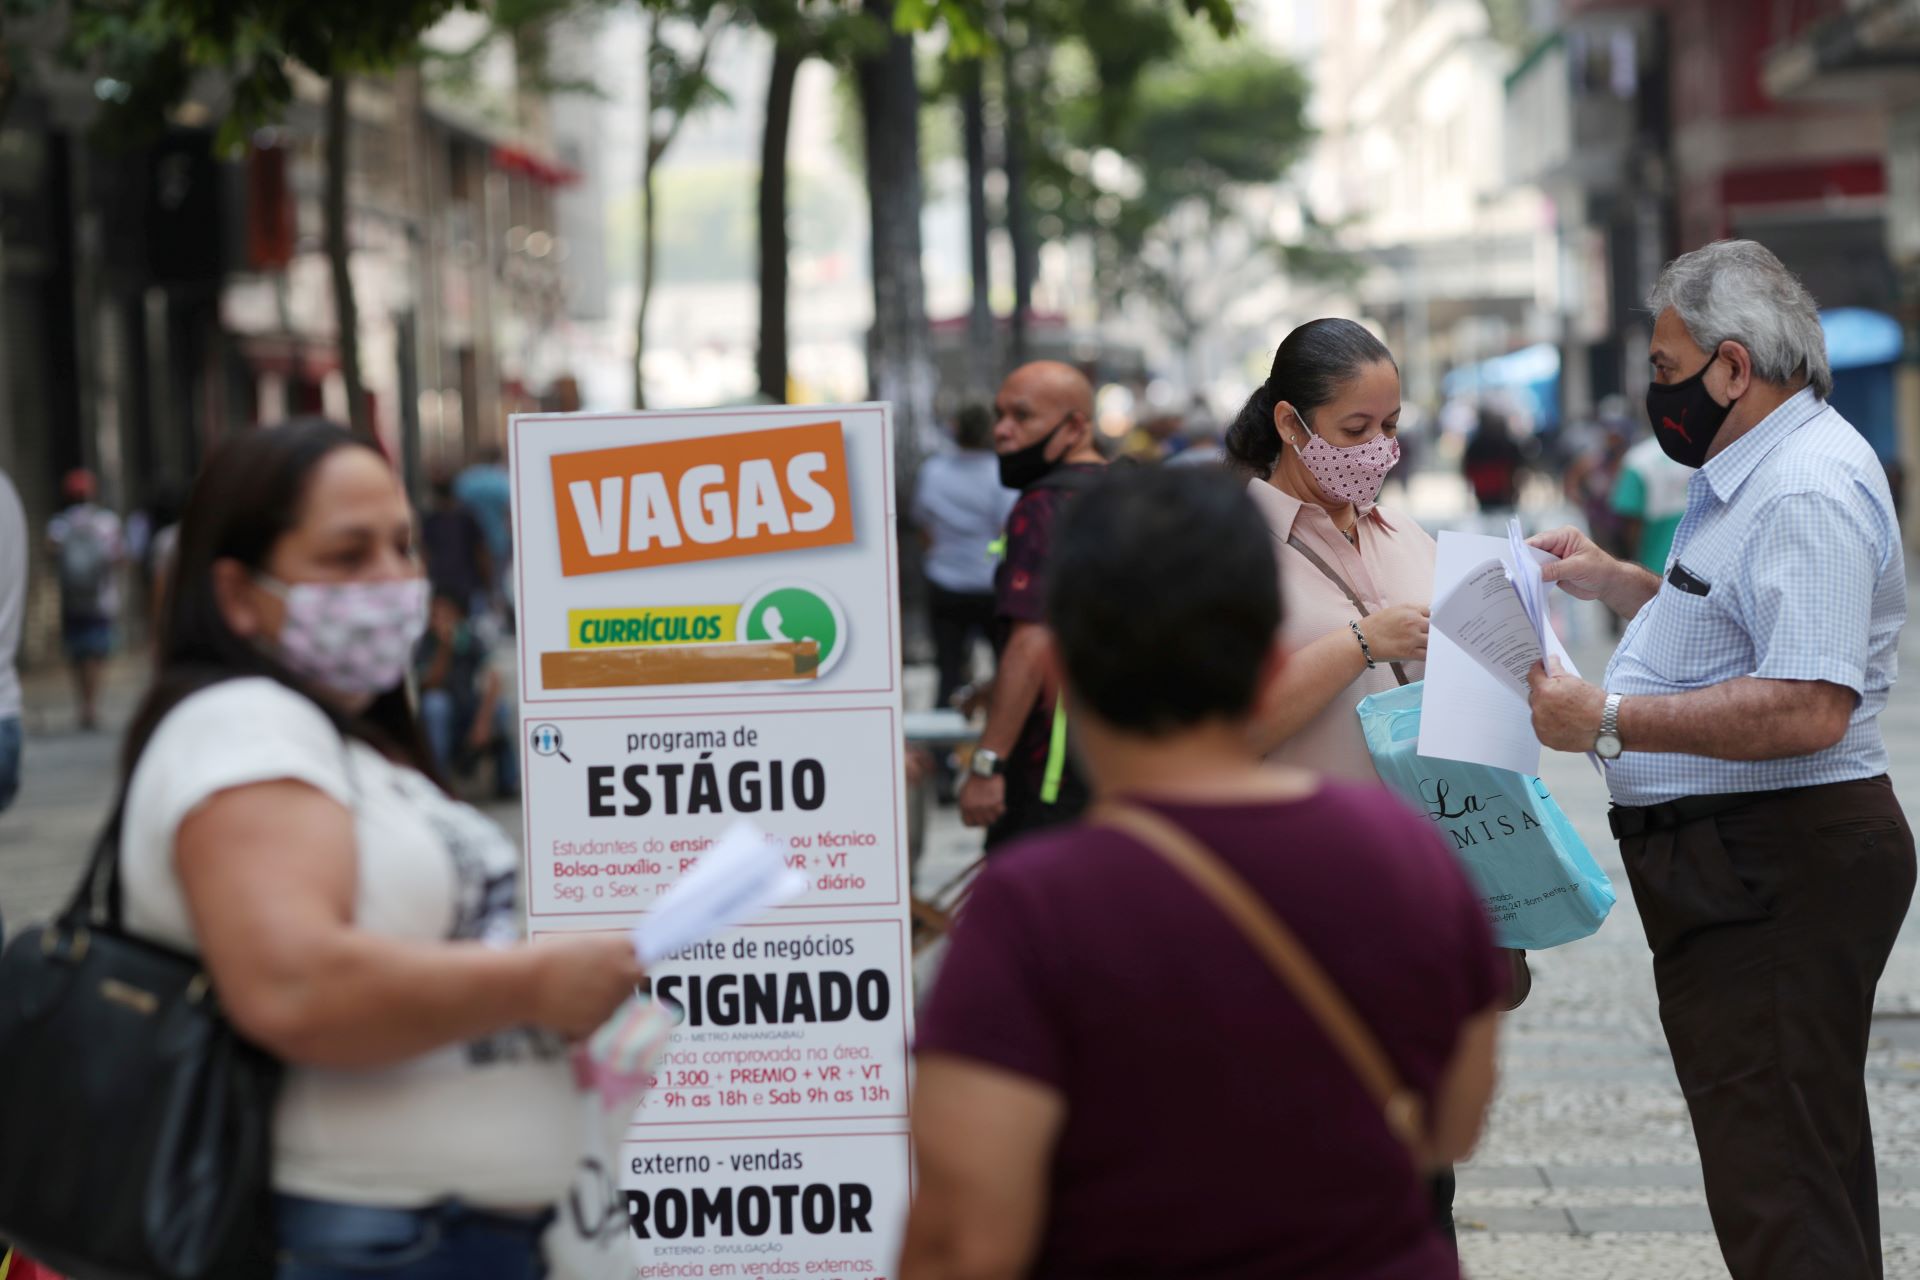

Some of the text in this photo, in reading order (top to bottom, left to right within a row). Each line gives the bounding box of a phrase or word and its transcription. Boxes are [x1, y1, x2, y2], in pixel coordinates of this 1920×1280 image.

[567, 451, 836, 557] VAGAS
[579, 613, 722, 644] CURRÍCULOS
[626, 726, 759, 754] programa de
[587, 752, 826, 817] ESTÁGIO
[1419, 778, 1487, 821] La
[1449, 810, 1540, 850] MISA
[552, 839, 637, 856] Estudantes
[643, 838, 664, 852] do
[670, 835, 717, 852] ensin
[790, 835, 812, 848] ou
[553, 858, 661, 877] Bolsa-auxílio
[826, 852, 848, 868] VT
[609, 881, 638, 898] Sex
[817, 874, 865, 891] diário
[733, 937, 757, 958] de
[764, 934, 854, 960] negócios
[641, 968, 890, 1027] SIGNADO
[702, 1046, 801, 1066] comprovada
[806, 1047, 828, 1060] na
[665, 1070, 709, 1086] 1.300
[730, 1066, 797, 1084] PREMIO
[818, 1065, 841, 1081] VR
[861, 1063, 882, 1080] VT
[664, 1092, 686, 1108] 9h
[691, 1095, 711, 1107] as
[718, 1090, 748, 1106] 18h
[753, 1093, 764, 1105] e
[768, 1087, 801, 1104] Sab
[807, 1086, 829, 1103] 9h
[833, 1090, 854, 1103] as
[860, 1085, 890, 1102] 13h
[632, 1153, 710, 1174] externo
[730, 1149, 803, 1171] vendas
[618, 1183, 873, 1239] ROMOTOR
[637, 1261, 704, 1278] eriência
[708, 1263, 736, 1276] em
[741, 1258, 800, 1275] vendas
